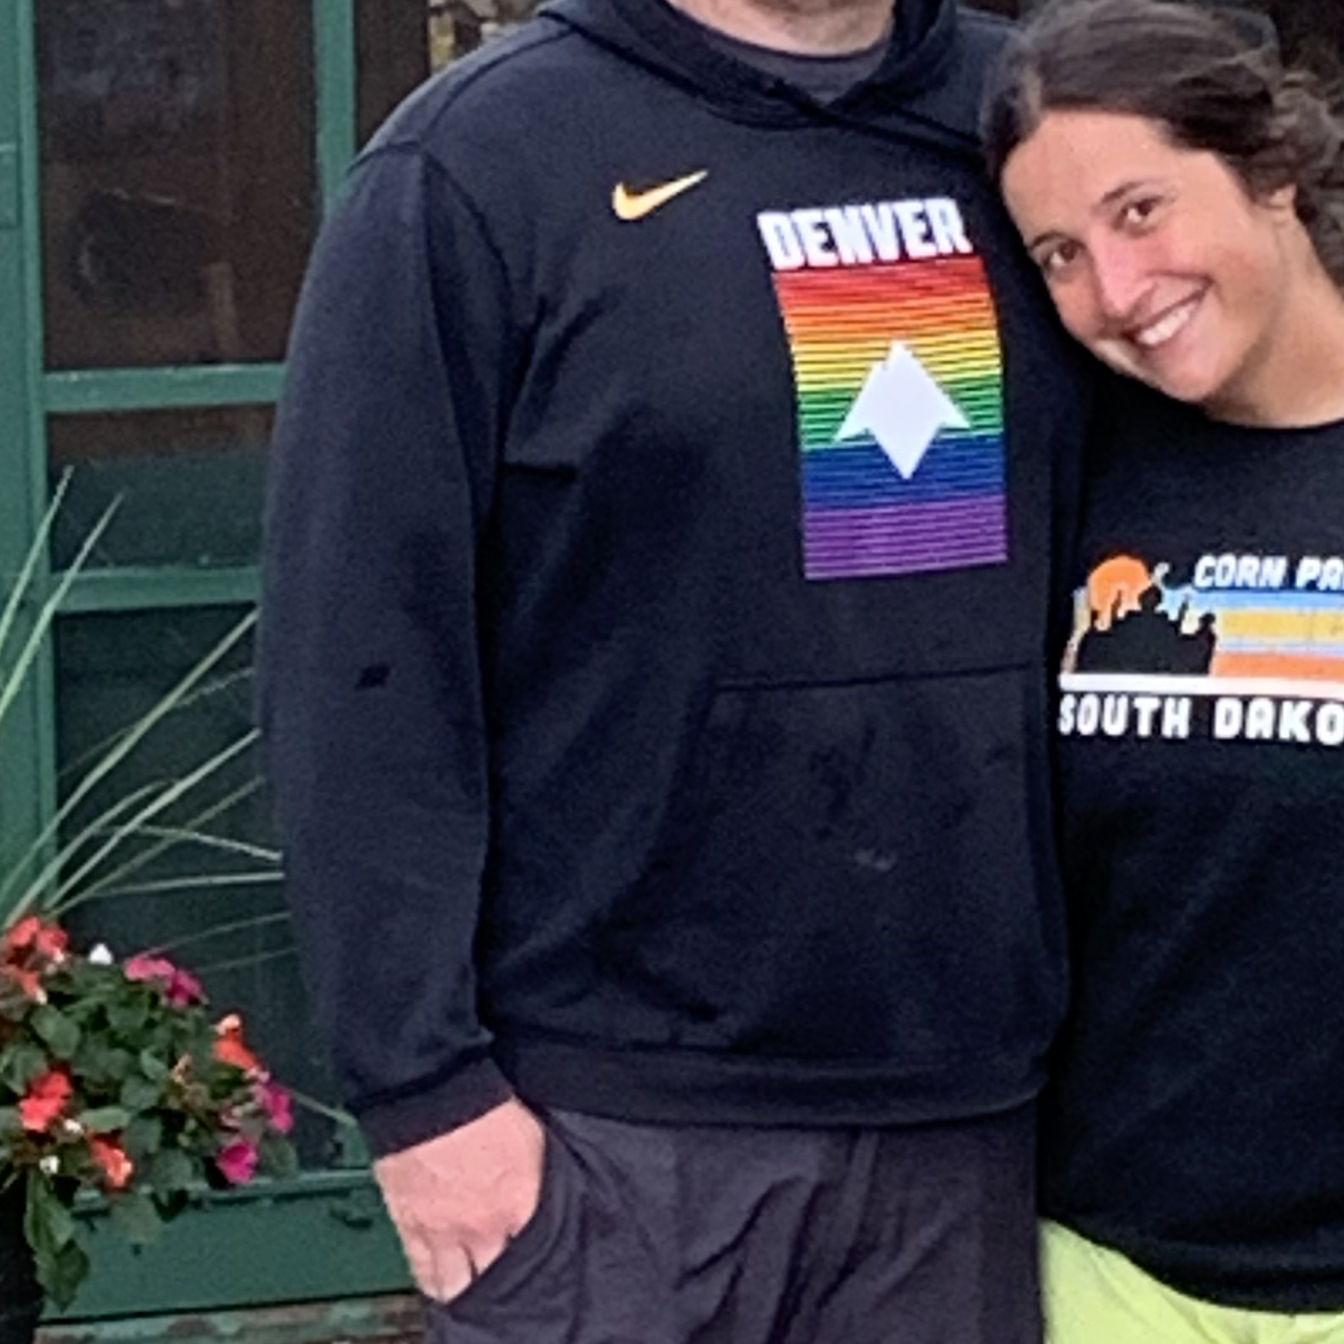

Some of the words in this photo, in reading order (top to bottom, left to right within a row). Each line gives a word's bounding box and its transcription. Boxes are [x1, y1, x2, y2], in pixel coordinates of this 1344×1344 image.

[757, 197, 973, 270] DENVER
[1193, 554, 1288, 590] CORN
[1058, 693, 1190, 739] SOUTH
